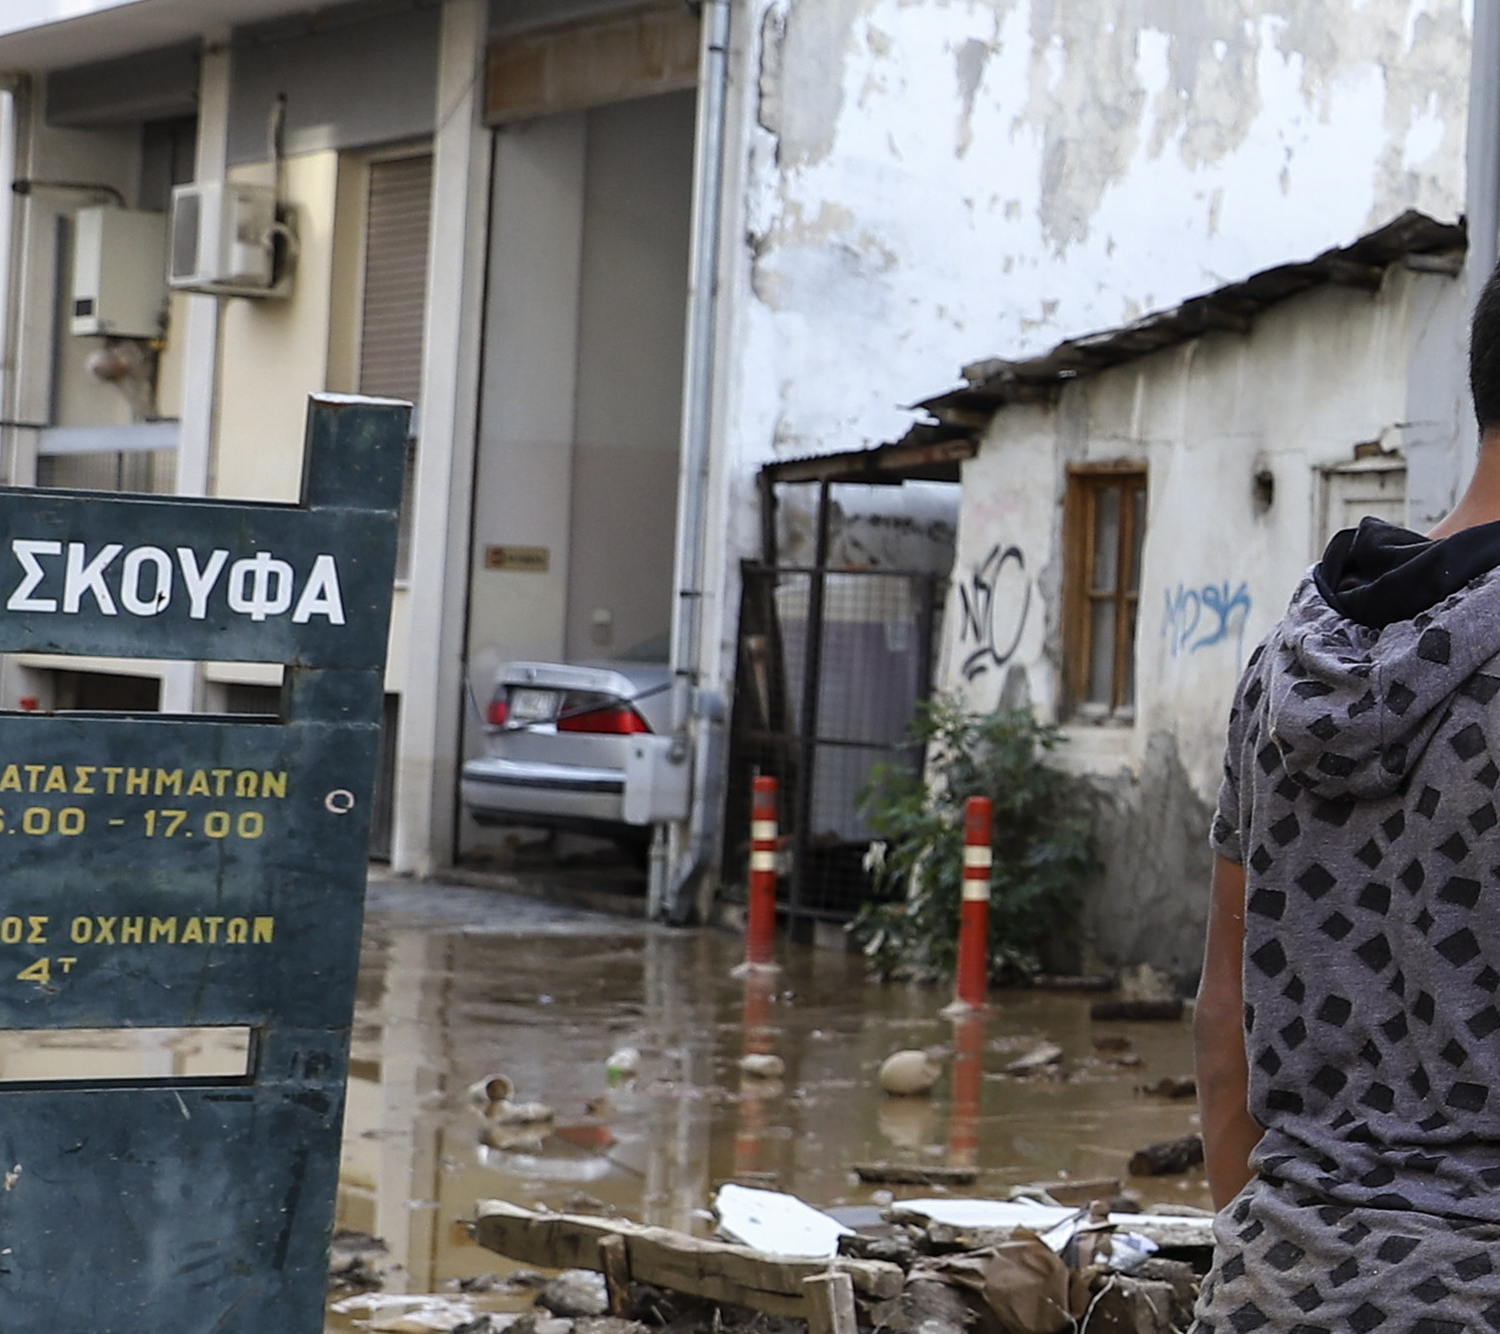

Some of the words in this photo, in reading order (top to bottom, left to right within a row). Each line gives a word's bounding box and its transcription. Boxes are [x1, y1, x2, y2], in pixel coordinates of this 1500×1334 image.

[7, 539, 345, 625] ΣΚΟΥΦΑ
[0, 764, 288, 798] ΑΤΑΣΤΗΜΑΤΩΝ
[0, 807, 86, 836] .00
[144, 809, 265, 839] 17.00
[0, 916, 49, 945] ΟΣ
[70, 916, 275, 946] ΟΧΗΜΑΤΩΝ
